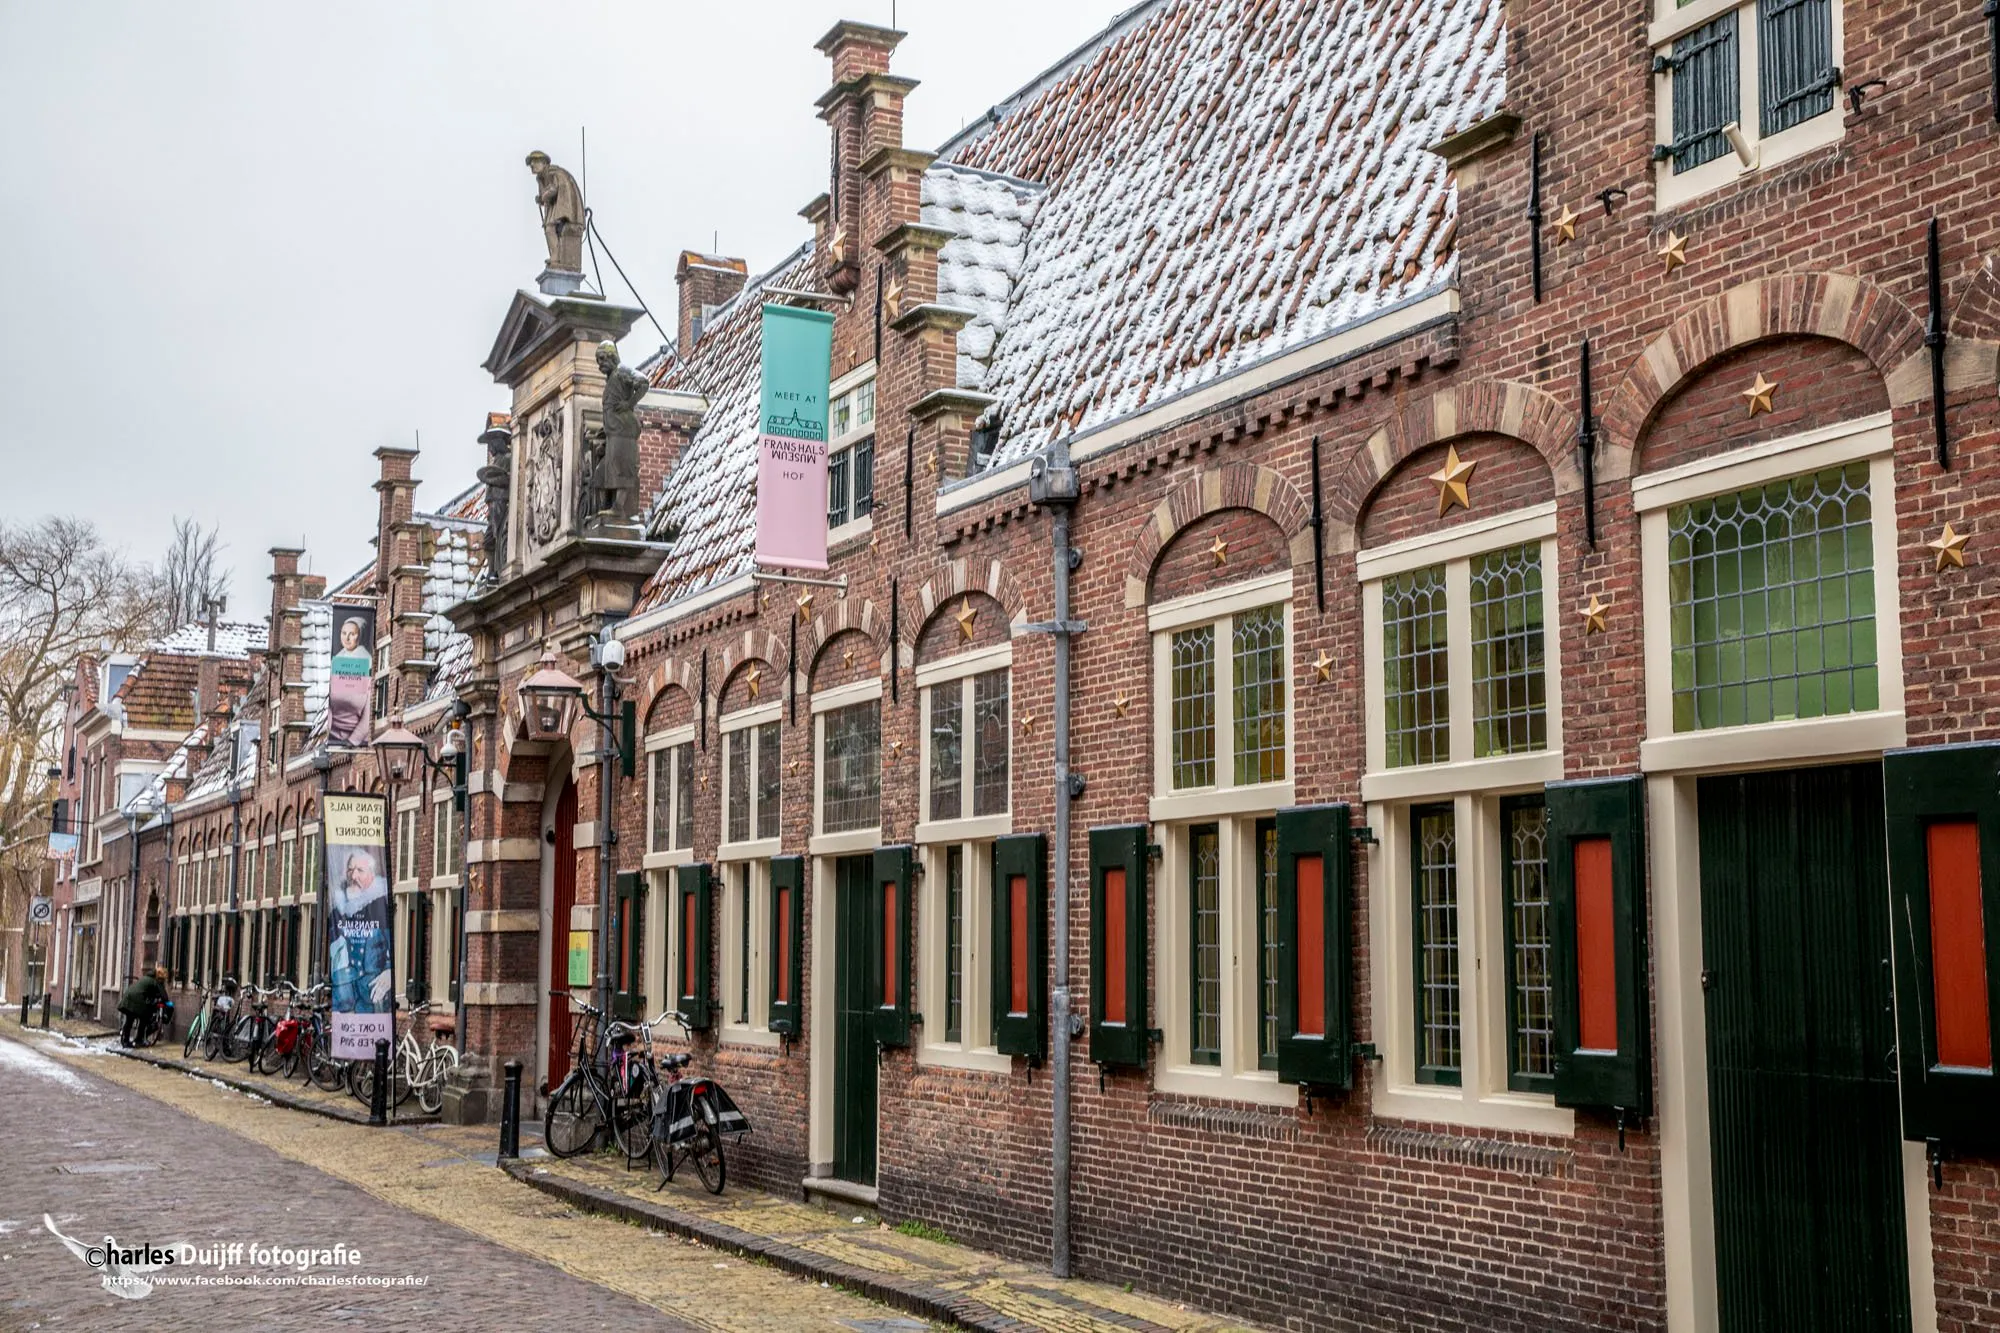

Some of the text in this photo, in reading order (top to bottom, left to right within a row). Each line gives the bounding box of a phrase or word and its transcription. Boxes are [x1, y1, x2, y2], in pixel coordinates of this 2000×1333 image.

[774, 391, 817, 404] MEET AT
[764, 438, 825, 456] FRANS HALS
[771, 450, 816, 464] MUSEUM
[783, 471, 805, 481] HOF
